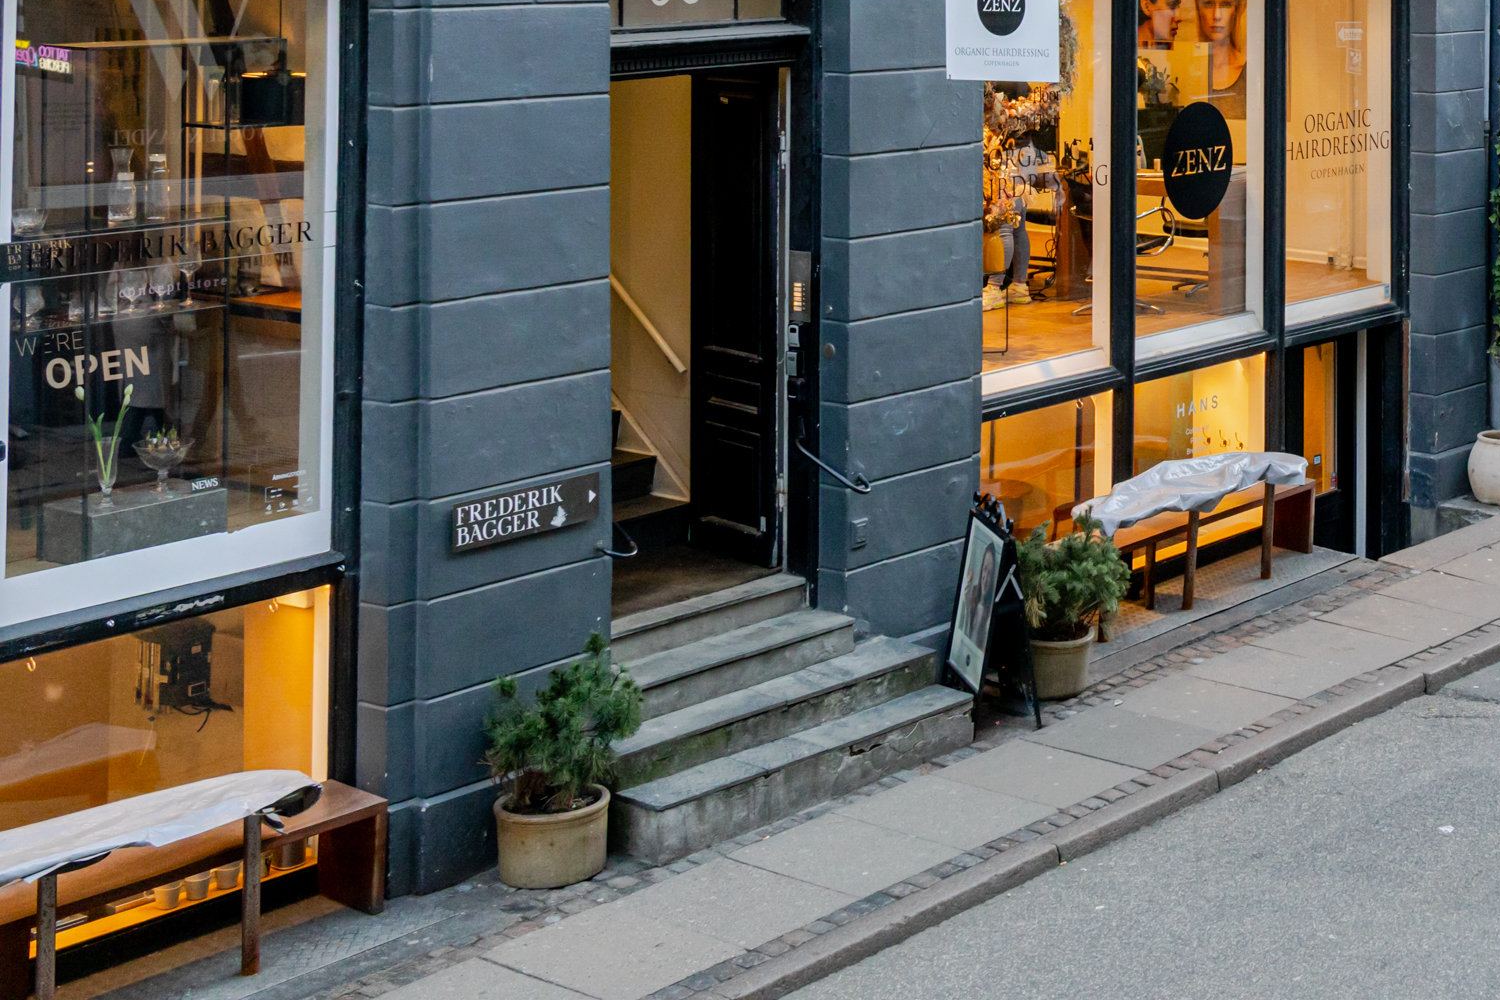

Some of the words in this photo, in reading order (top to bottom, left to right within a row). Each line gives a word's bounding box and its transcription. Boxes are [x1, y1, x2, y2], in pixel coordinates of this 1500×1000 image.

[954, 46, 991, 57] ORGANIC
[992, 47, 1050, 58] HAIRDRESSING
[1304, 108, 1372, 134] ORGANIC
[1286, 130, 1390, 161] HAIRDRESSING
[1171, 145, 1226, 178] ZENZ
[1310, 163, 1365, 180] COPENHAGEN
[202, 220, 315, 252] BAGGER
[188, 276, 228, 290] store
[46, 346, 150, 389] OPEN
[1176, 395, 1218, 418] HANS
[191, 477, 219, 491] NEWS
[455, 484, 564, 527] FREDERIK
[455, 510, 541, 547] BAGGER
